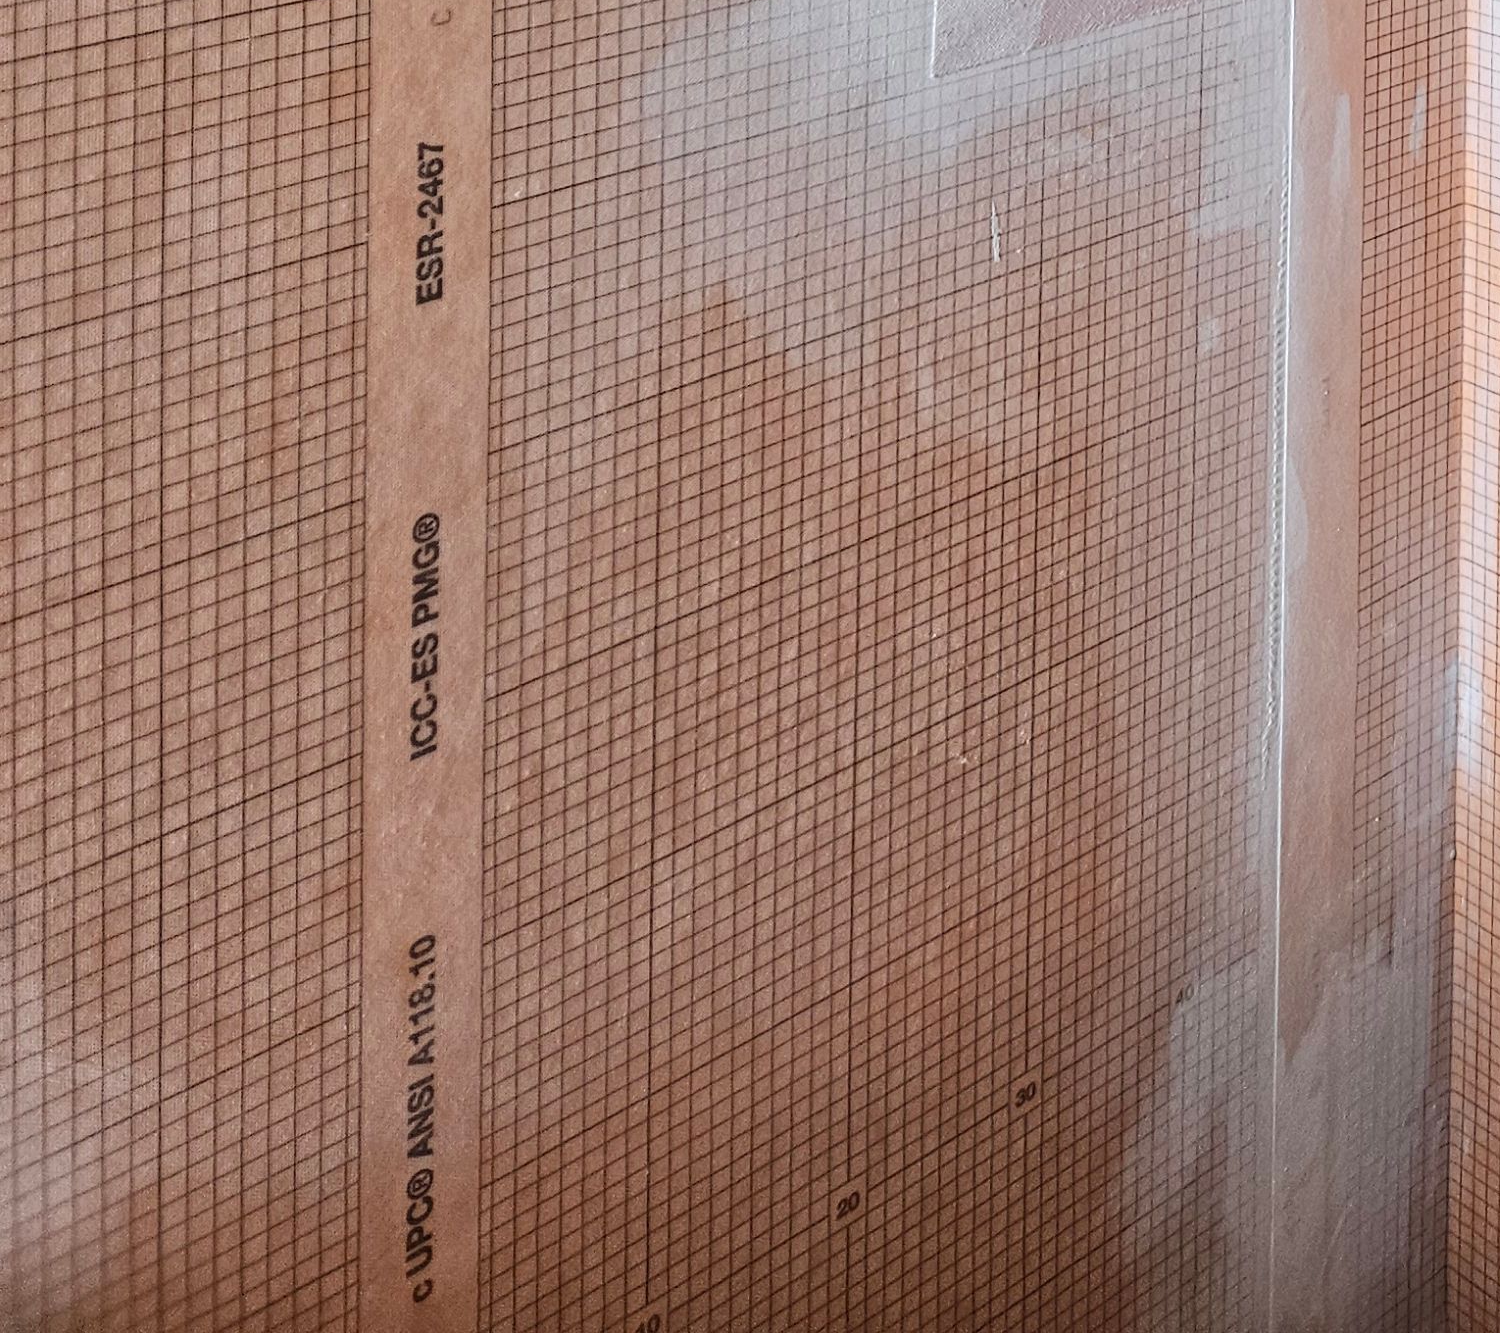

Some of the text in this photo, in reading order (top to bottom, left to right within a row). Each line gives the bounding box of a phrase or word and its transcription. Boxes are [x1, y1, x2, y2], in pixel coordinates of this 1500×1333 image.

[431, 9, 453, 26] C
[416, 142, 444, 306] ESR-2467
[410, 633, 438, 761] ICC-ES
[408, 934, 436, 1066] A118.10
[407, 1073, 434, 1159] ANSI
[836, 1191, 860, 1221] 20
[1015, 1082, 1037, 1108] 30
